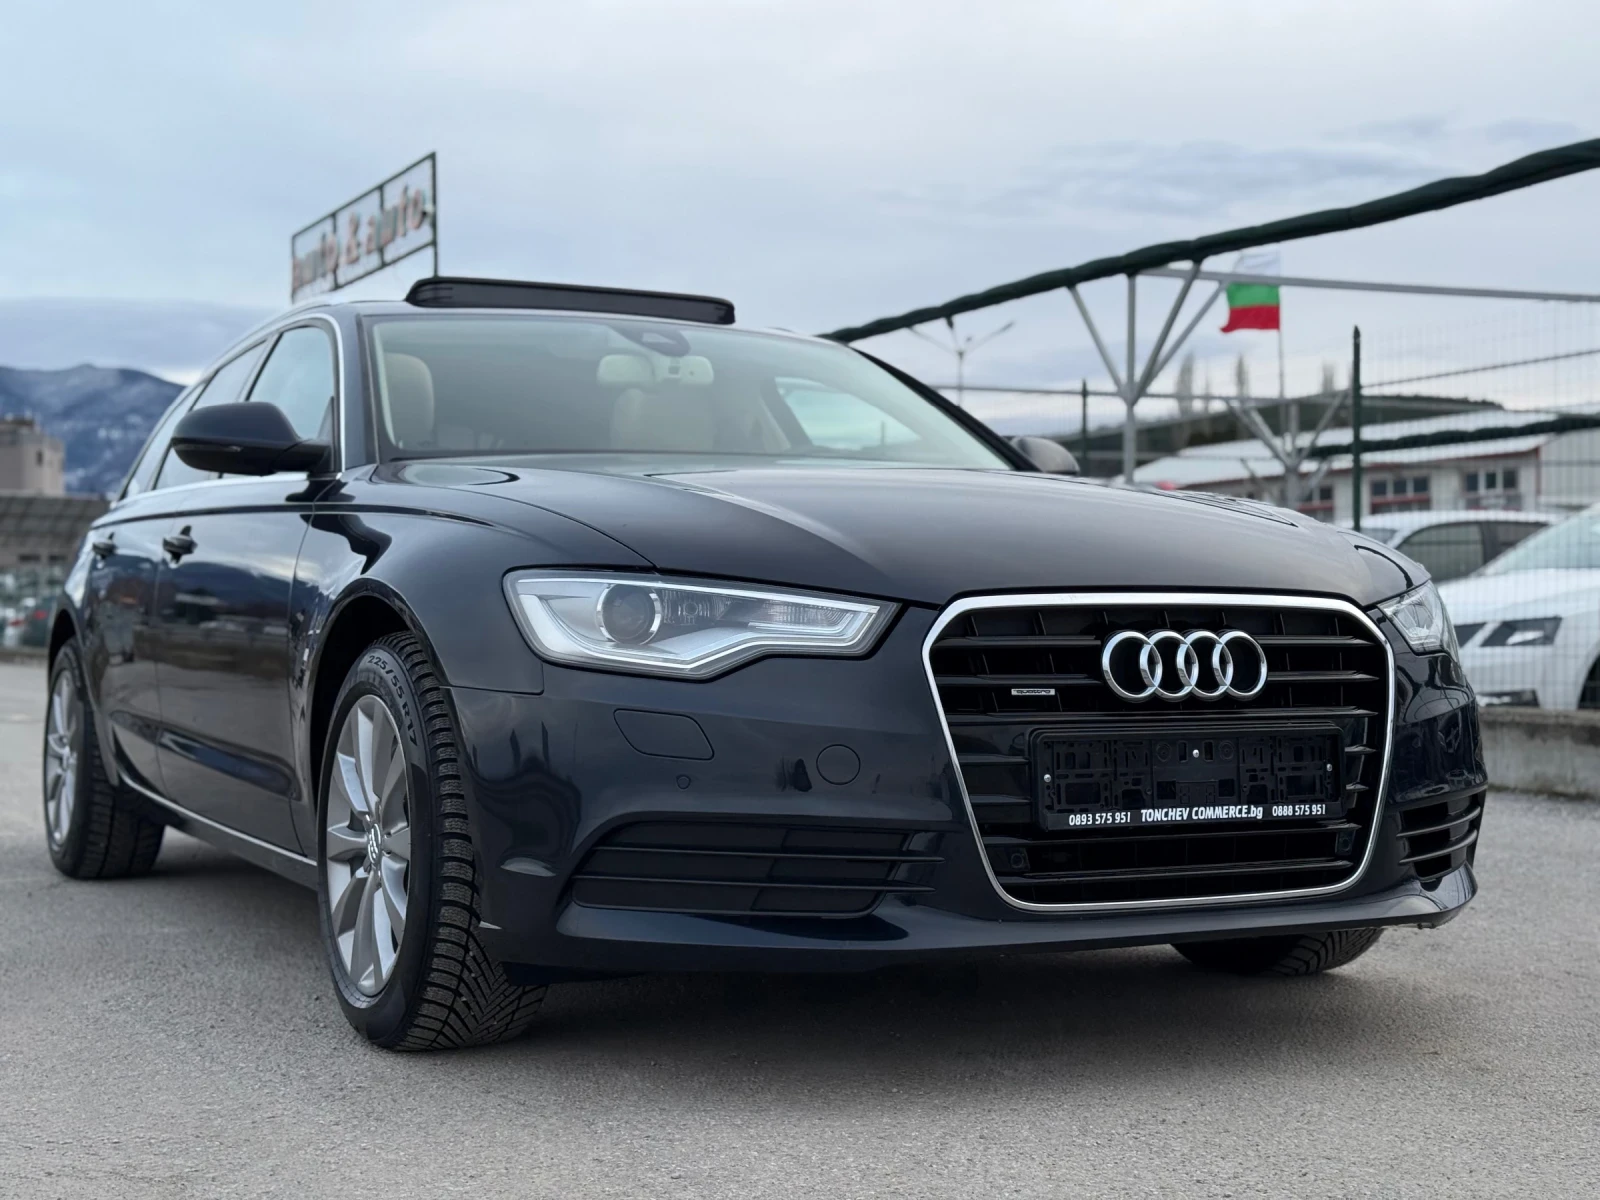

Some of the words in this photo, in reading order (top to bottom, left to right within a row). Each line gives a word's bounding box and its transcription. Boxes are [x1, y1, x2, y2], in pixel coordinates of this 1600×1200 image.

[367, 655, 405, 699] 225/55
[402, 701, 418, 747] R17
[1068, 813, 1093, 826] 0893
[1095, 812, 1113, 824] 575
[1114, 811, 1131, 823] 951
[1140, 807, 1190, 822] TONCHEV
[1191, 804, 1264, 820] COMMERCE.bg
[1272, 805, 1293, 817] 0888
[1294, 804, 1311, 816] 575
[1311, 803, 1326, 815] 951
